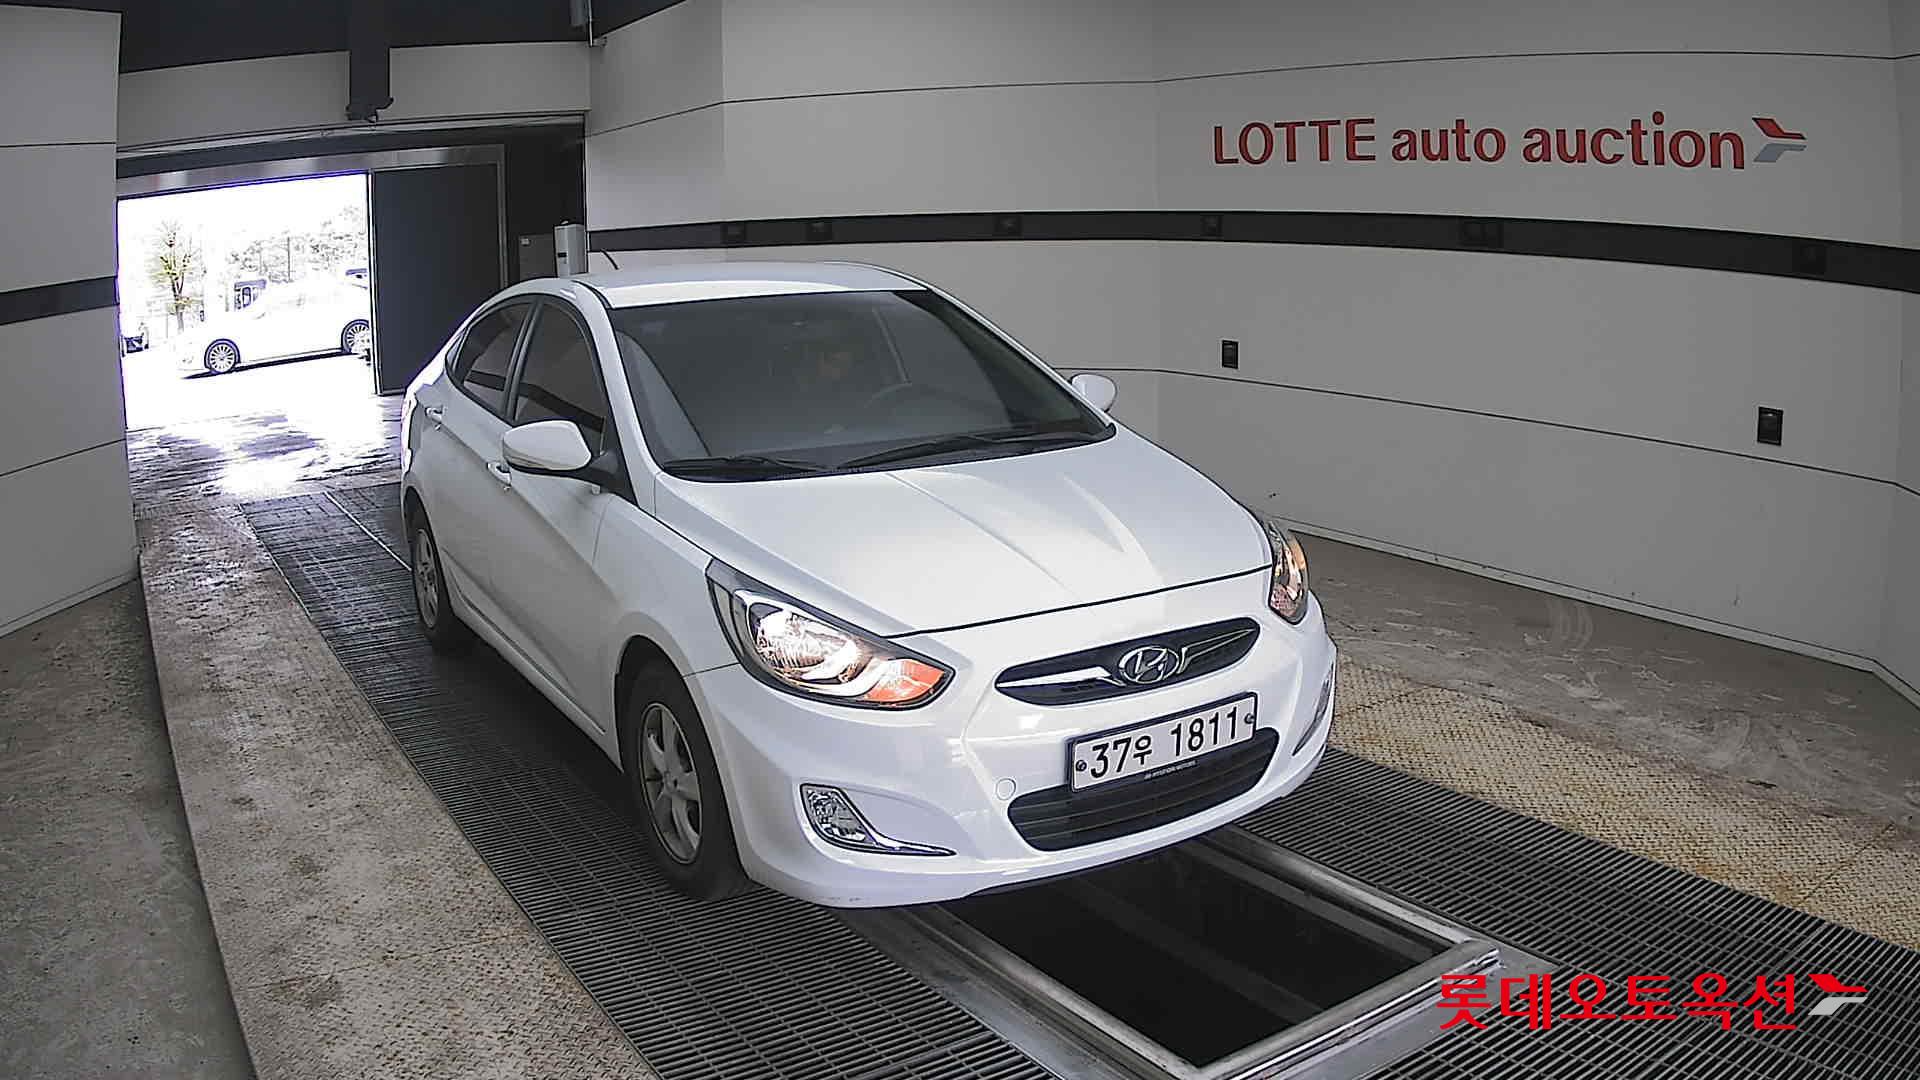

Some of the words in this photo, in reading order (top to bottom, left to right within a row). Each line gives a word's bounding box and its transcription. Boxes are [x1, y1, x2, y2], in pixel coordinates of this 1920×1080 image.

[1214, 118, 1377, 164] LOTTE
[1392, 118, 1508, 161] auto
[1523, 111, 1745, 169] auction
[1090, 735, 1152, 779] 37우
[1170, 706, 1237, 757] 1811
